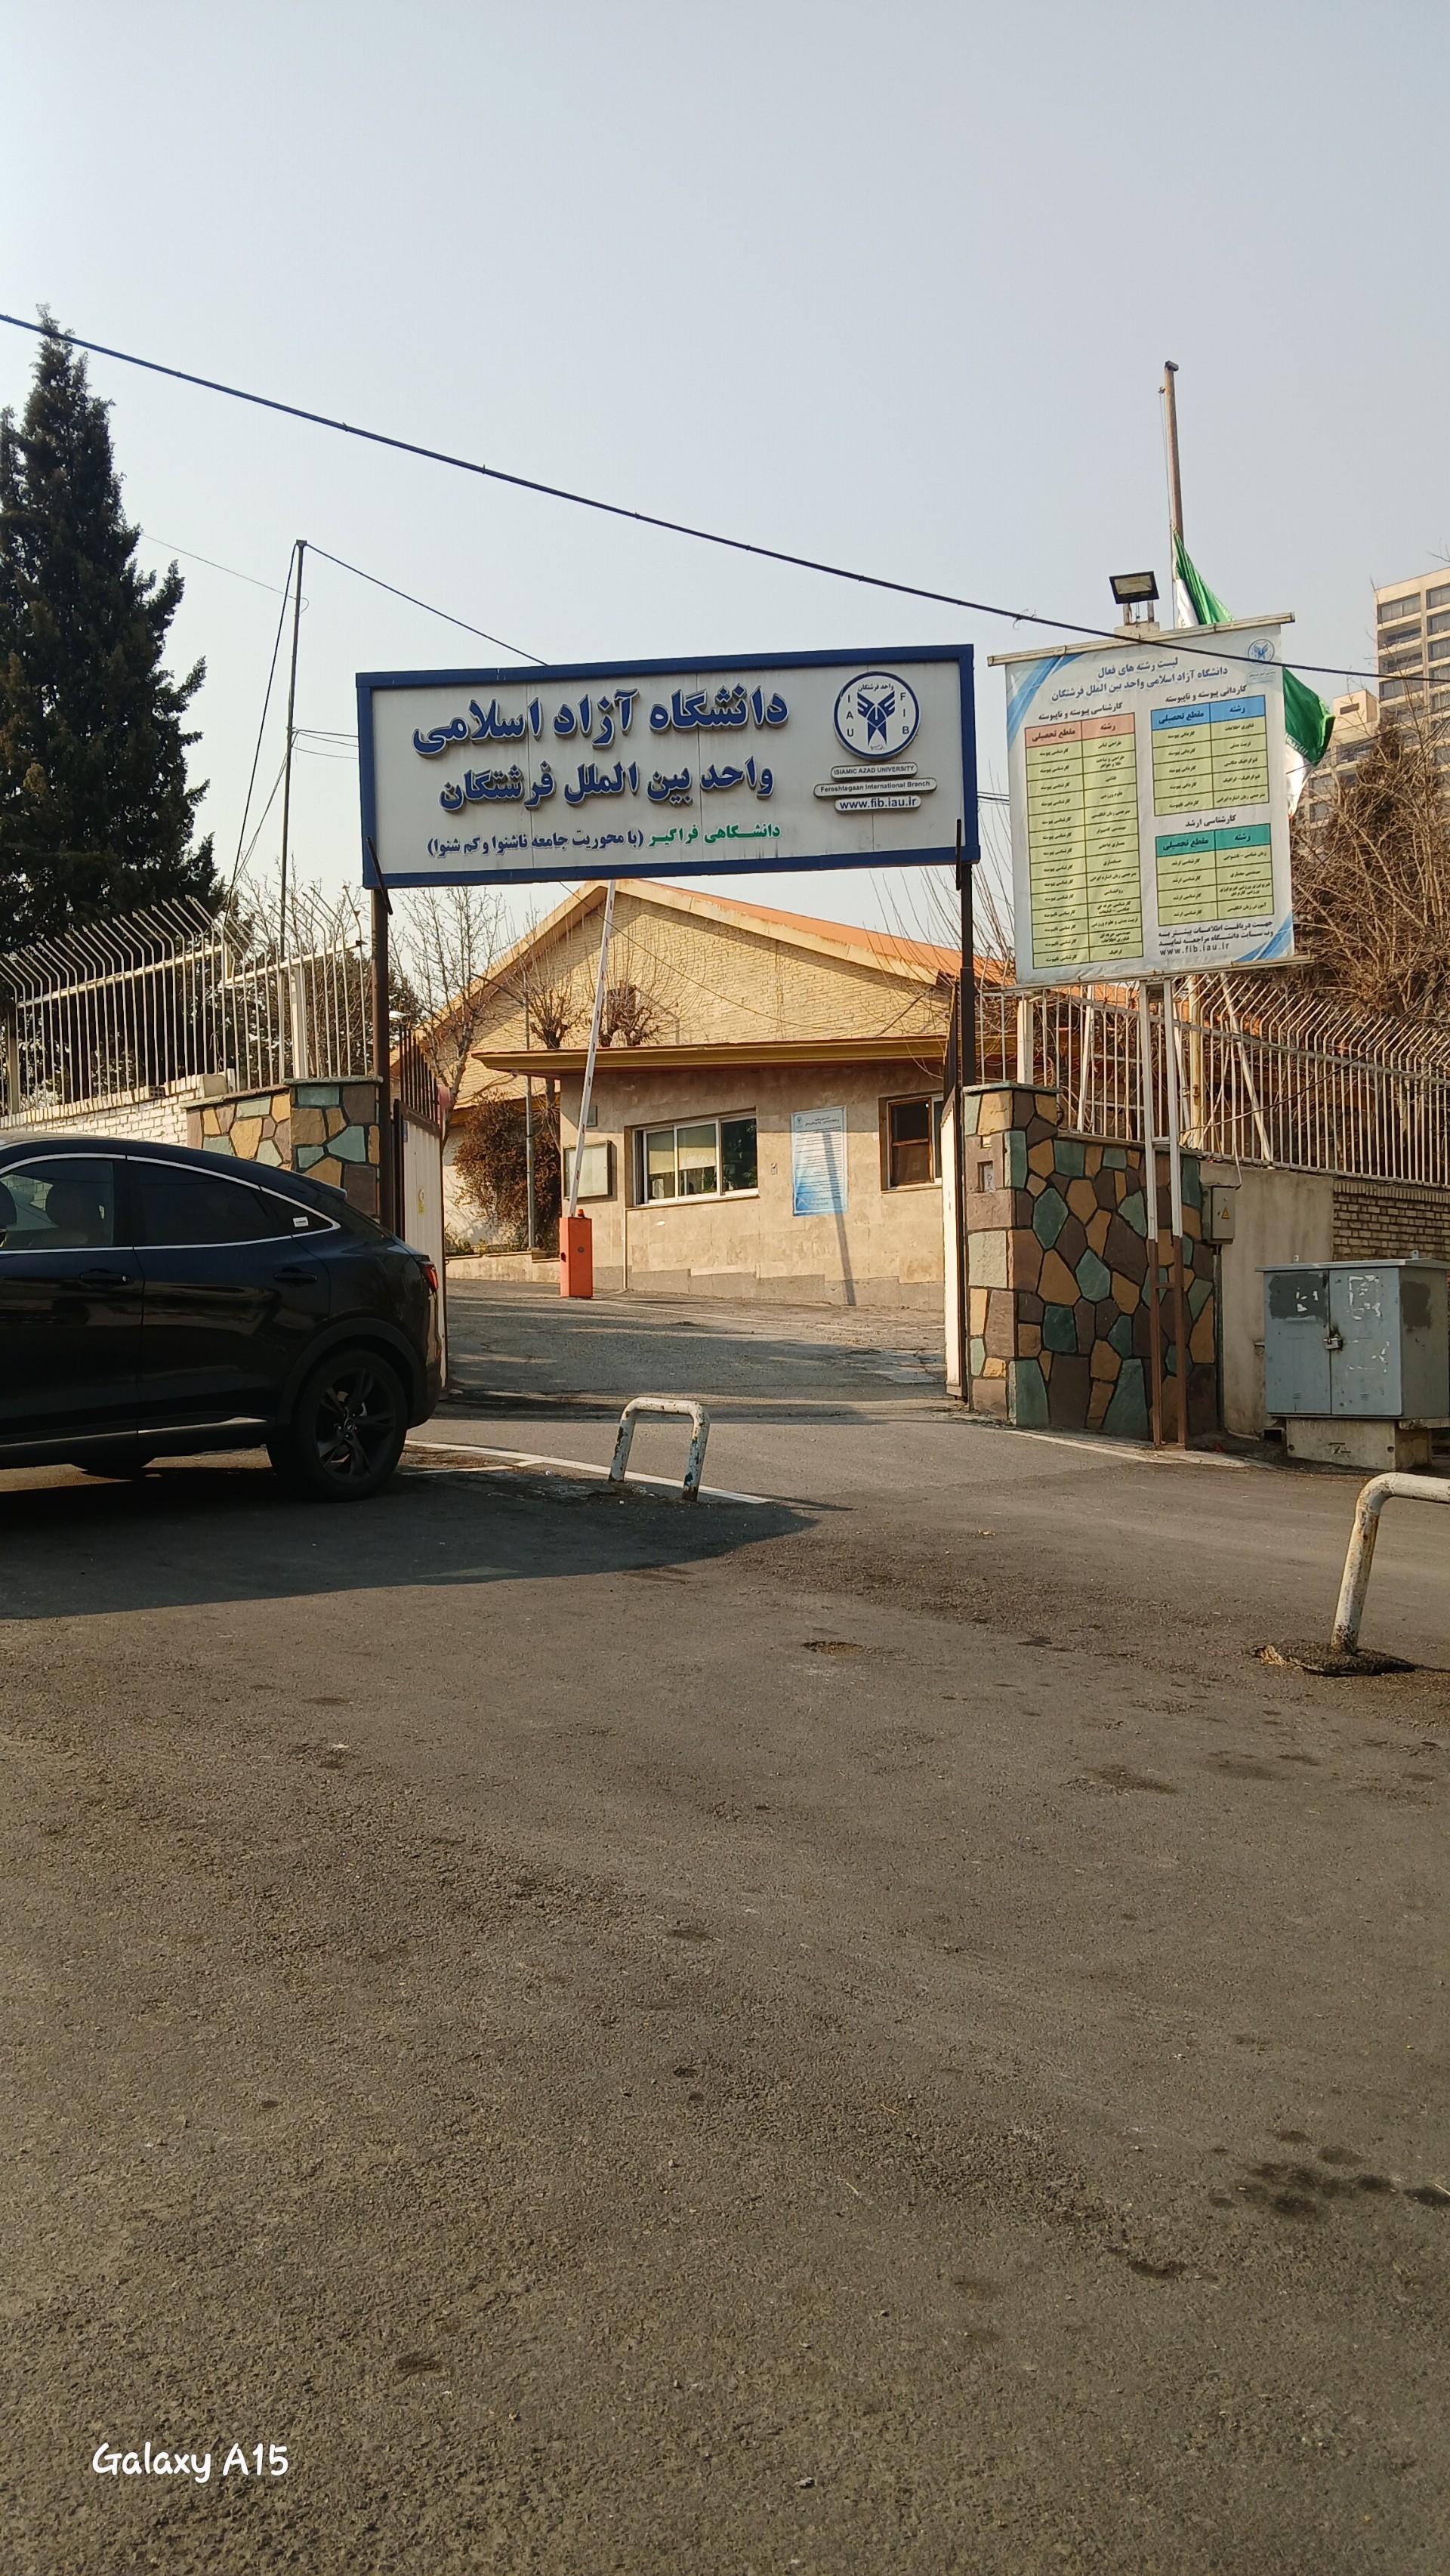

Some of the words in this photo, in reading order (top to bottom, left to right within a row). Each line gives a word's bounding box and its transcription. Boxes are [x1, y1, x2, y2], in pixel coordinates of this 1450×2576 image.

[1098, 665, 1115, 678] فعال
[1118, 664, 1134, 675] های
[1137, 662, 1155, 671] رشته
[1158, 657, 1178, 668] لیست
[649, 683, 788, 733] دانشگاه
[412, 696, 542, 756] اسلامی
[553, 688, 639, 748] آزاد
[700, 756, 773, 799] واحد
[877, 765, 915, 773] UNIVERSITY
[564, 760, 640, 807] الملل
[647, 767, 693, 804] بین
[865, 781, 905, 790] International
[907, 779, 930, 788] Branch
[840, 796, 917, 810] www.fib.iau.ir
[1186, 819, 1202, 828] ارشد
[1204, 814, 1236, 826] کارشناسی
[532, 832, 568, 850] جامعه
[572, 830, 624, 850] محوریت
[648, 824, 699, 847] فراگیر
[704, 822, 781, 844] دانشگاهی
[464, 836, 481, 854] کم
[482, 841, 489, 855] و
[492, 833, 529, 854] ناشنوا
[1160, 942, 1229, 955] www.fib.iau.ir
